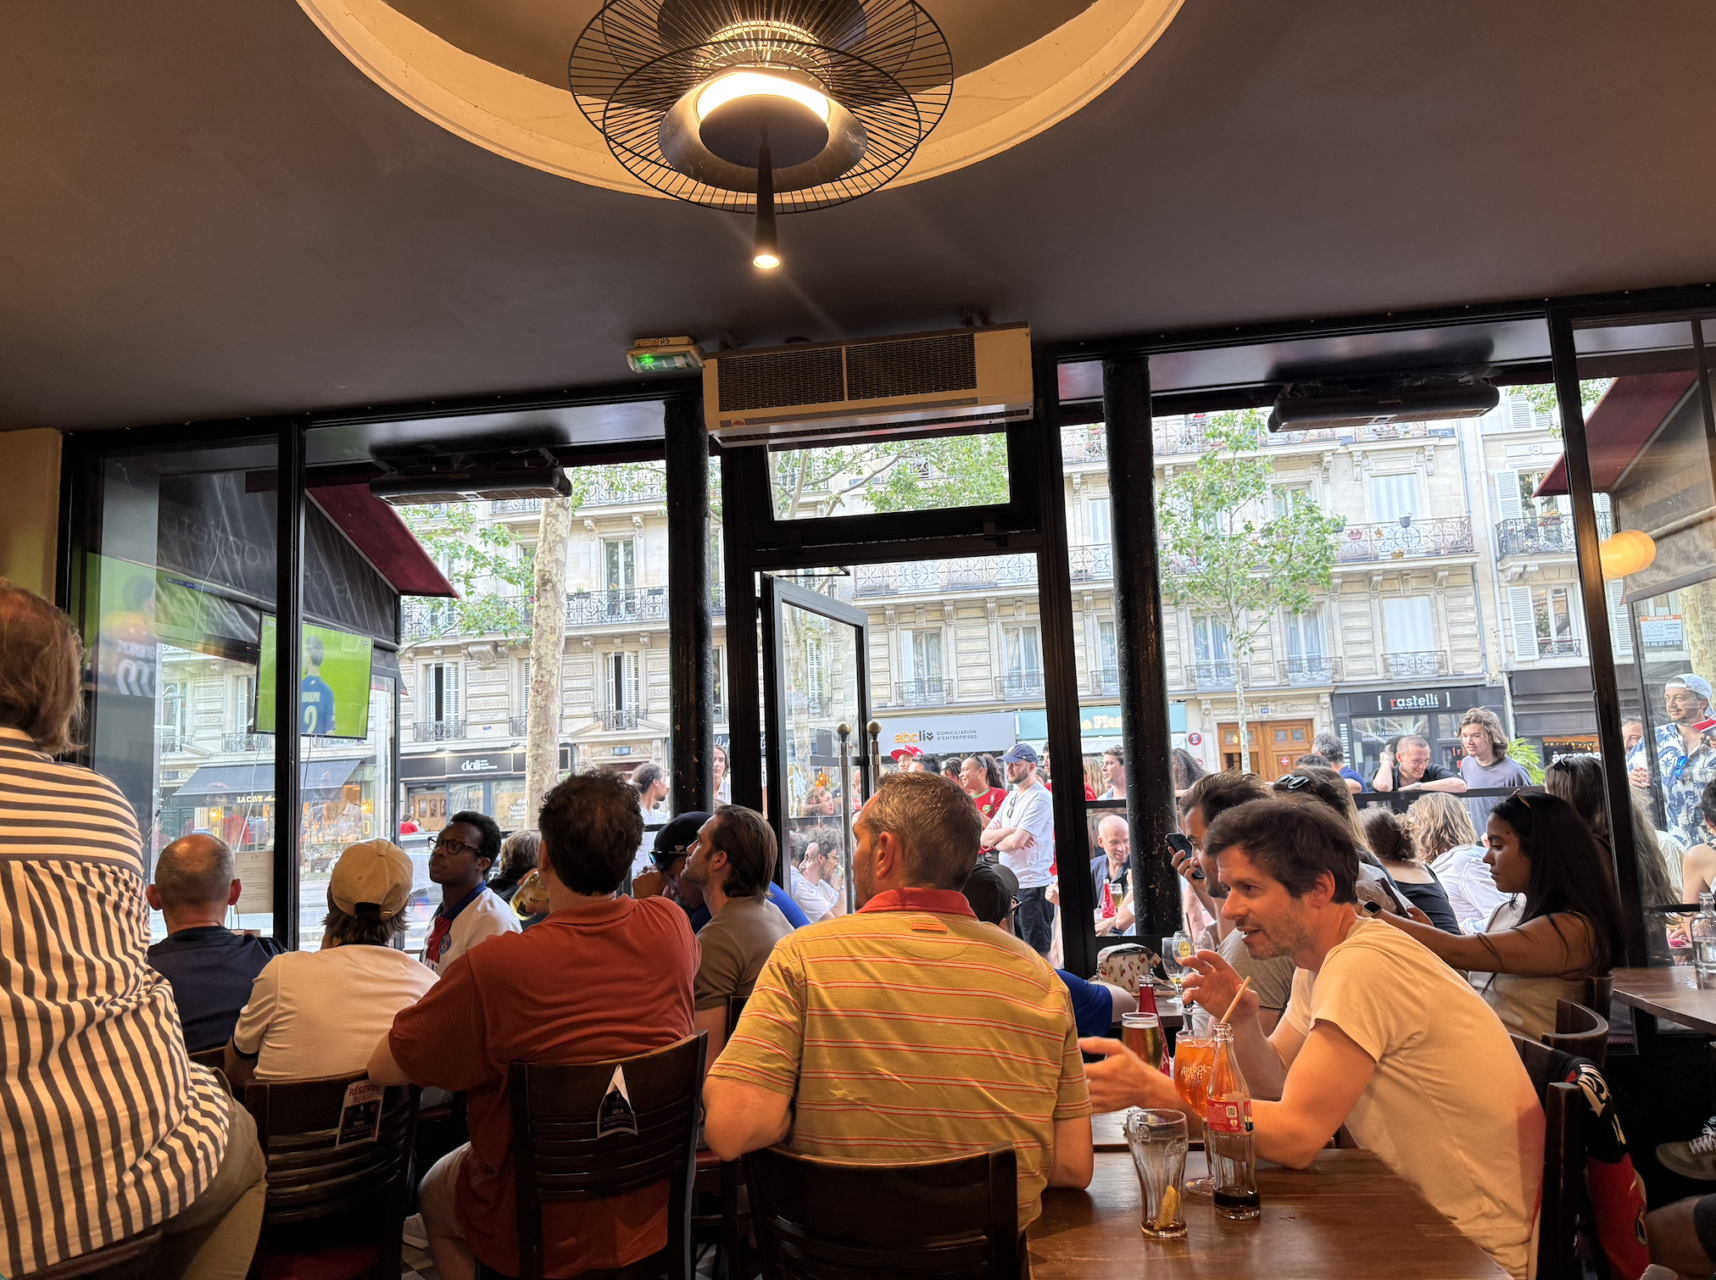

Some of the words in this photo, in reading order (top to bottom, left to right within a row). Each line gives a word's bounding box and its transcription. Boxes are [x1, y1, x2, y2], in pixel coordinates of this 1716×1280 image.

[1390, 693, 1439, 708] rastelli
[304, 705, 317, 734] 2
[1180, 1064, 1207, 1076] APEROL
